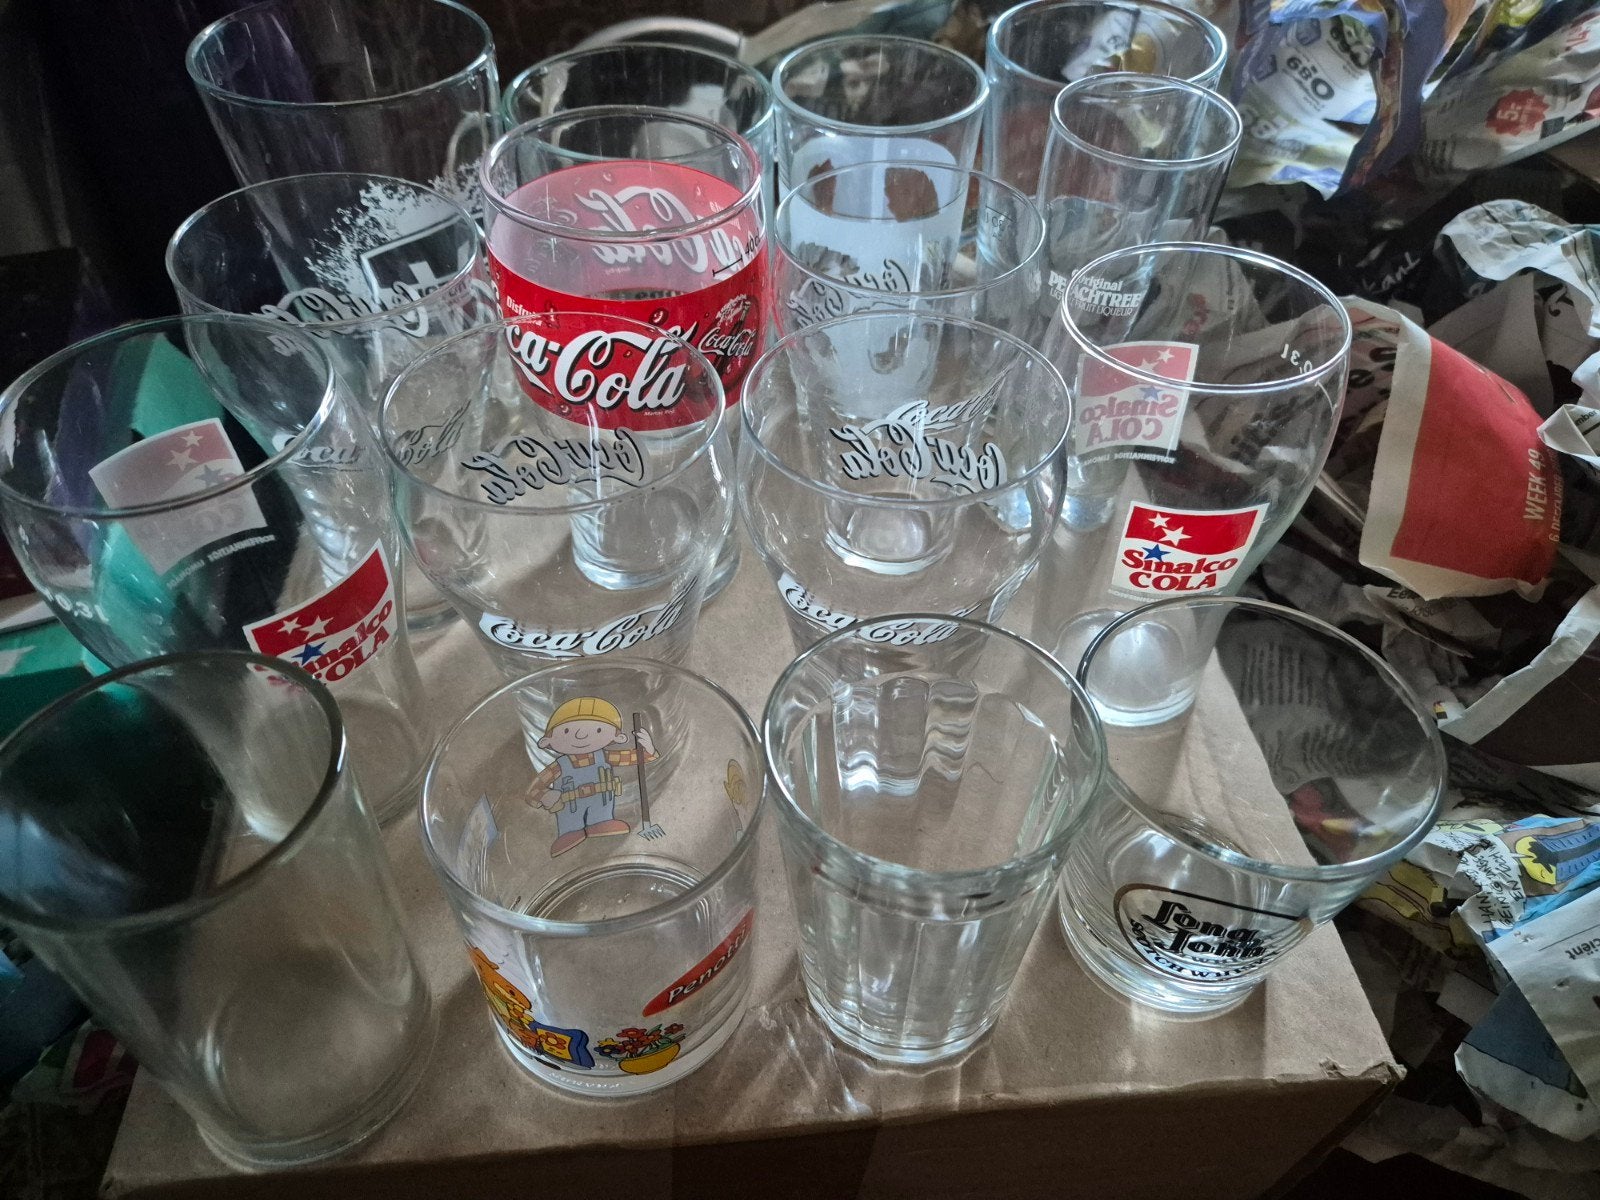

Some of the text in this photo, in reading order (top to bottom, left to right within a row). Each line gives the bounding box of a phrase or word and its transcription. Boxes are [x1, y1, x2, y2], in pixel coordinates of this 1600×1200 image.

[1523, 448, 1548, 520] WEEK 49
[1122, 549, 1238, 574] Sinalco
[1129, 571, 1217, 591] COLA
[291, 599, 393, 675] inalco
[314, 625, 390, 682] OLA
